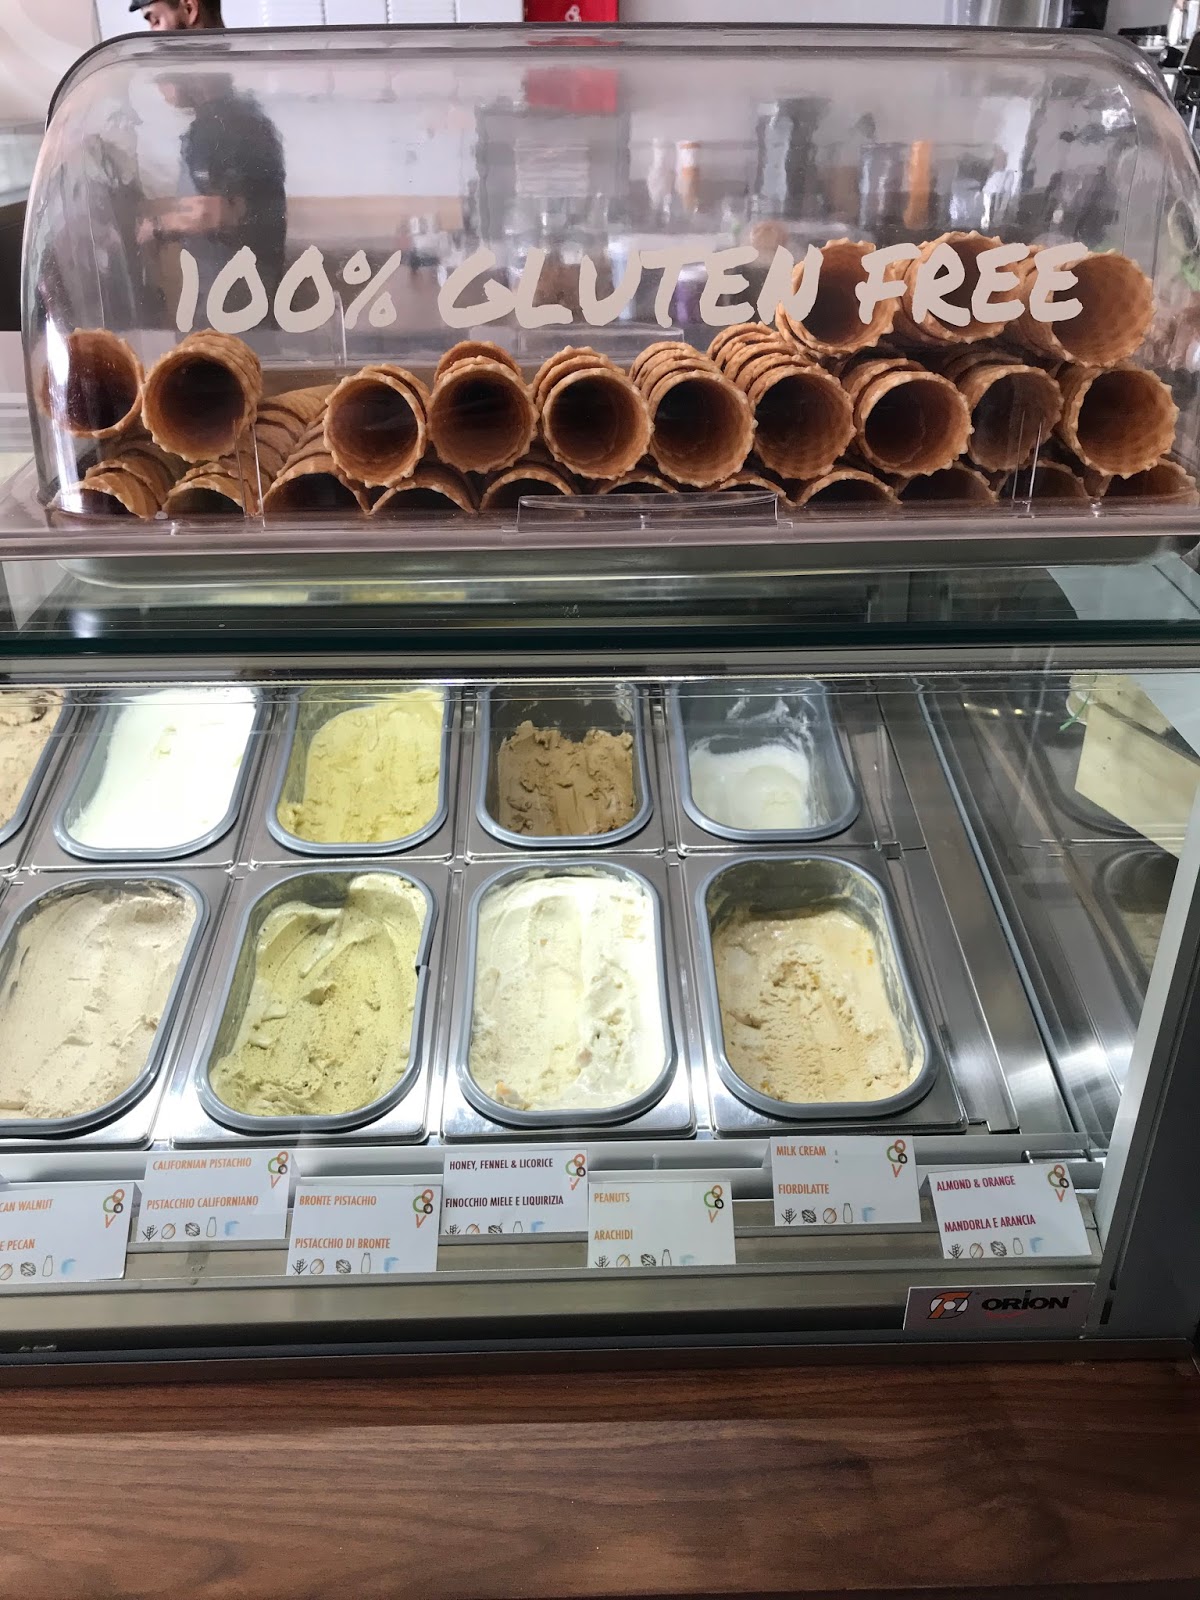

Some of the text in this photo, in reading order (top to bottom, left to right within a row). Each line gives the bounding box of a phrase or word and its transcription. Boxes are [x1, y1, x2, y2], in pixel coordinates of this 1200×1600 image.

[176, 242, 1088, 334] 100% GLUTEN FREE
[776, 1145, 827, 1156] MILK CREAM
[152, 1157, 252, 1171] CALIFORNIAN PISTACHIO
[449, 1158, 554, 1171] HONEY, FENNEL & LICORICE
[777, 1183, 830, 1195] FIORDILATTE
[936, 1175, 1016, 1192] ALMOND & ORANGE
[146, 1195, 259, 1211] PISTACCHIO CALIFORNIANO
[299, 1195, 377, 1206] BRONTE PISTACHIO
[445, 1195, 564, 1209] FINOCCHIO MIELE E LIQUIRIZIA
[593, 1192, 631, 1203] PEANUTS
[18, 1198, 54, 1211] WALNUT
[944, 1214, 1036, 1232] MANDORLA E ARANCIA
[593, 1229, 633, 1240] ARACHIDI
[7, 1238, 36, 1251] PECAN
[294, 1238, 391, 1249] PISTACCHIO DI BRONTE
